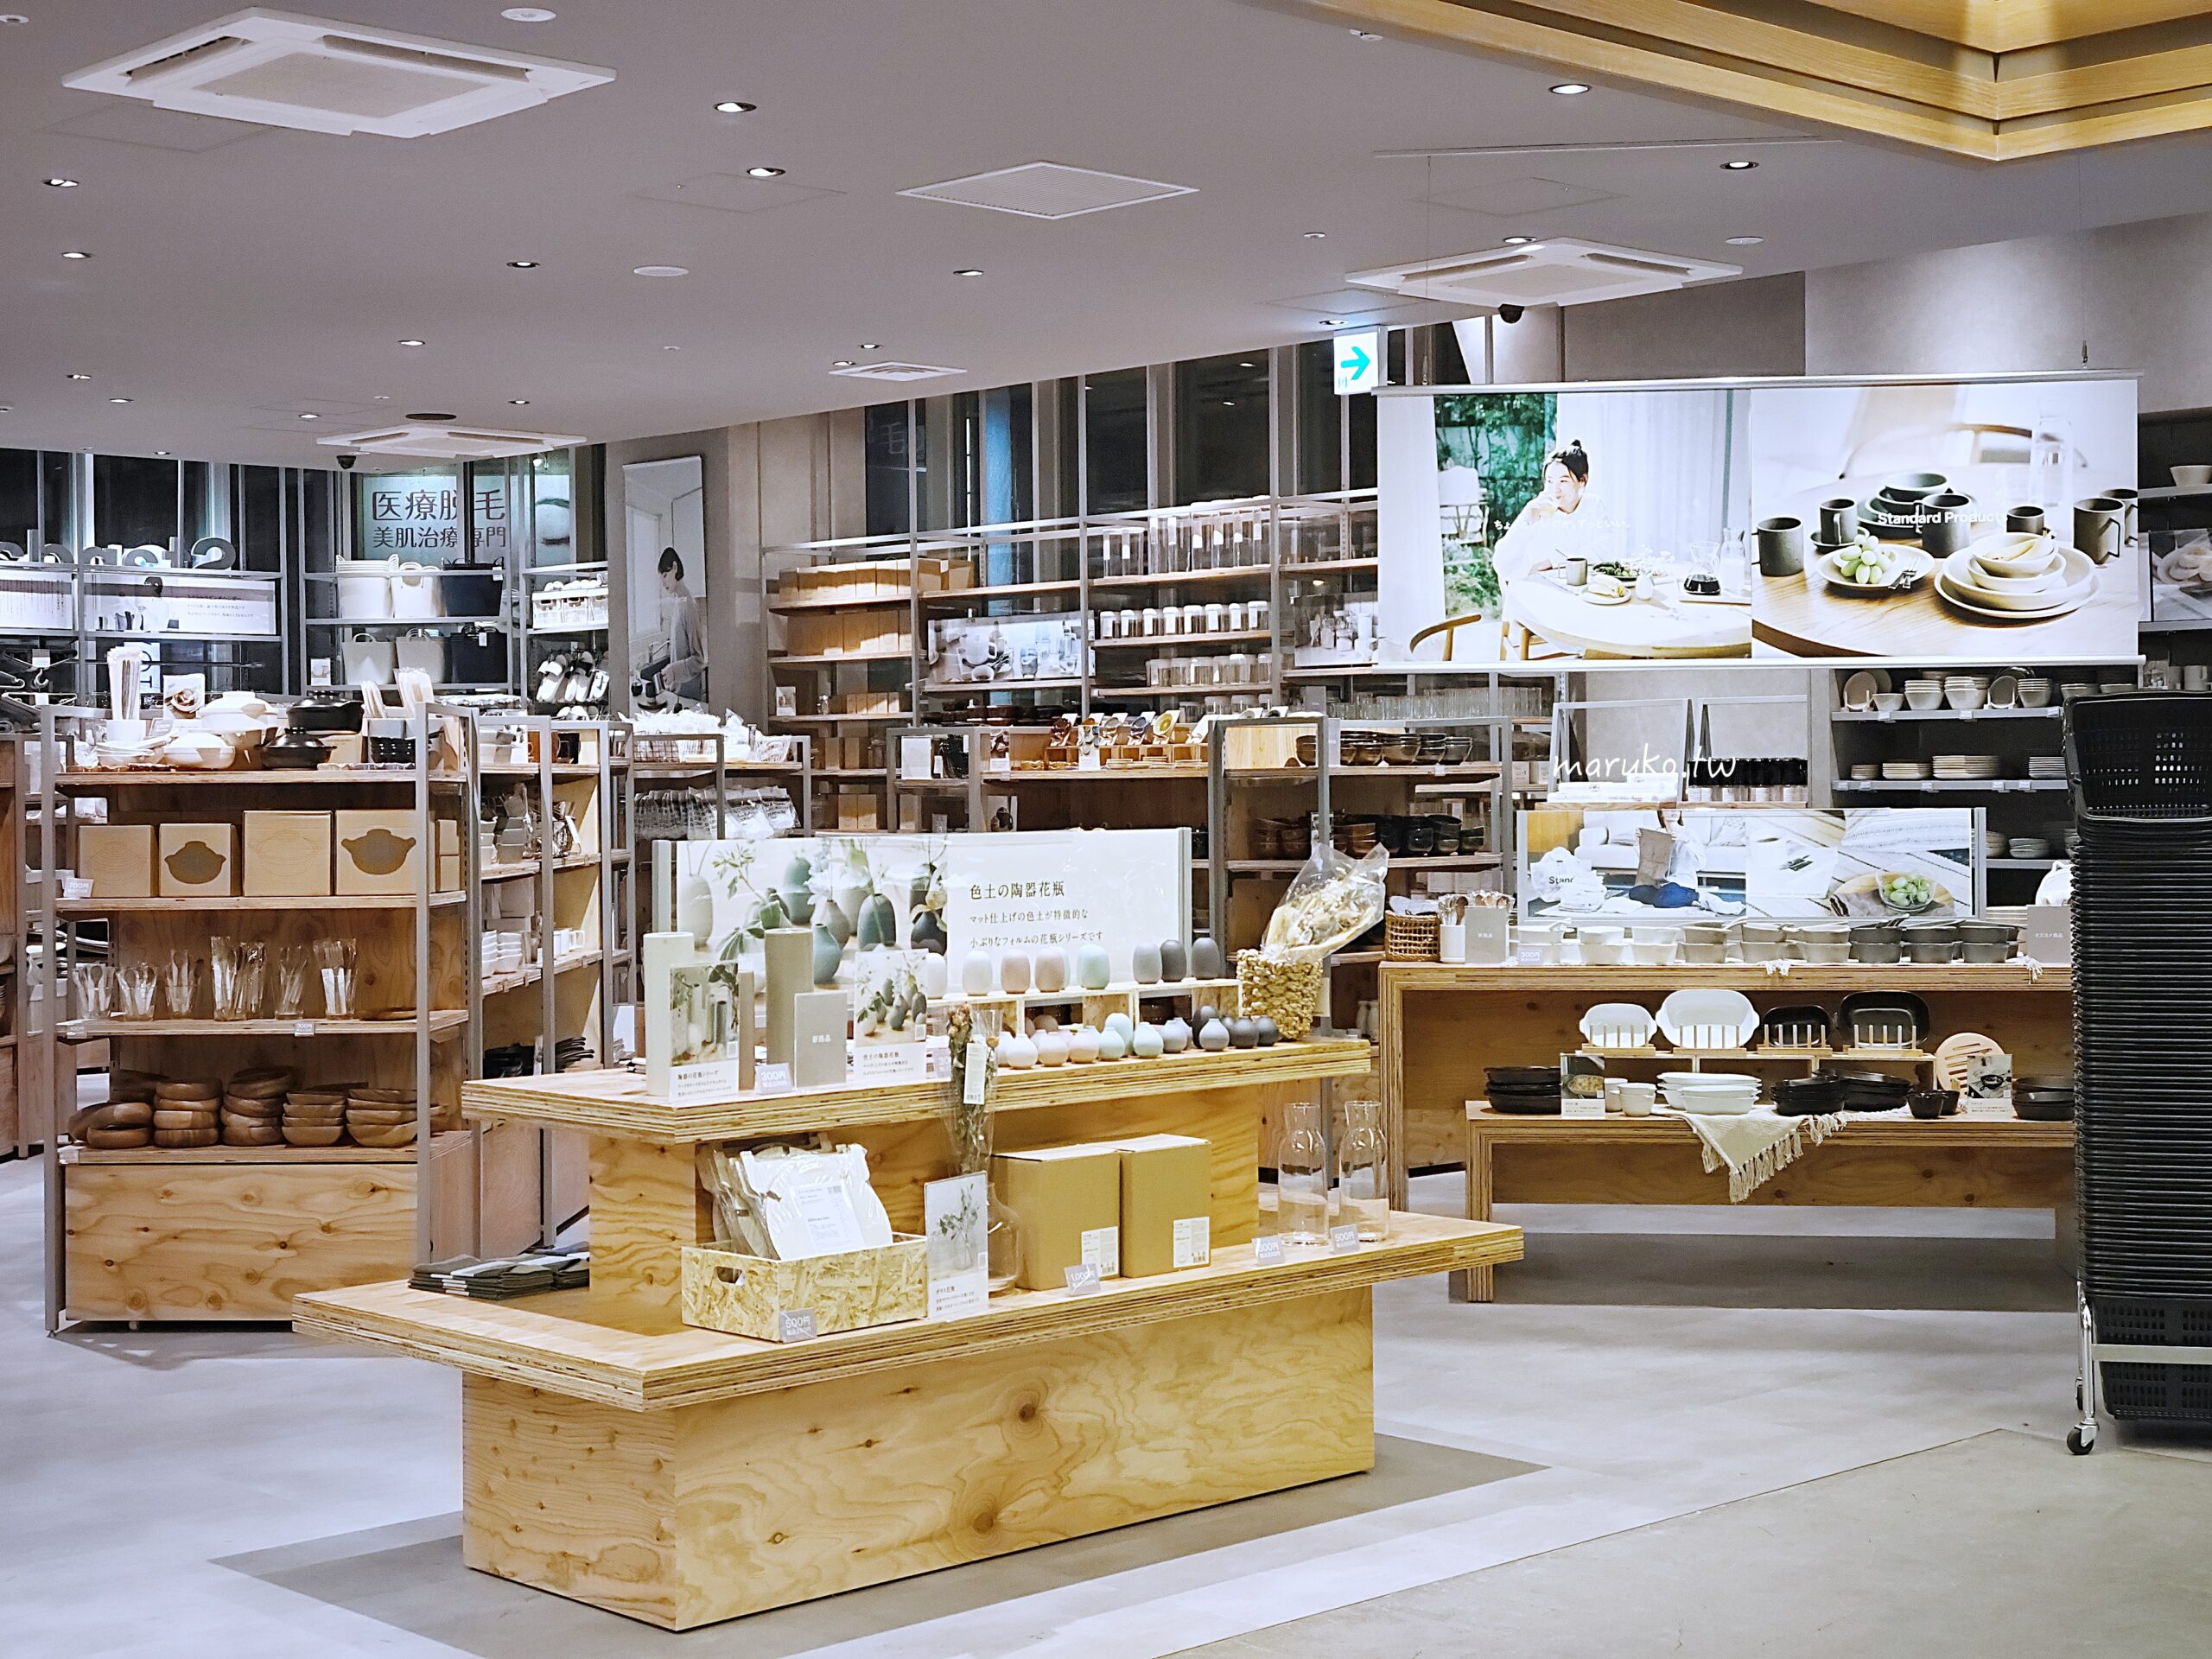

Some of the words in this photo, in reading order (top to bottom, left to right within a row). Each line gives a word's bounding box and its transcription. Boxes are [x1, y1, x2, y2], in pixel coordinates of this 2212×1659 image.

[372, 488, 505, 521] 医療脱毛
[1878, 512, 1942, 525] Standard
[970, 880, 1065, 900] 色土の陶器花瓶
[969, 908, 1089, 925] マット仕上げの色土が特徴的な
